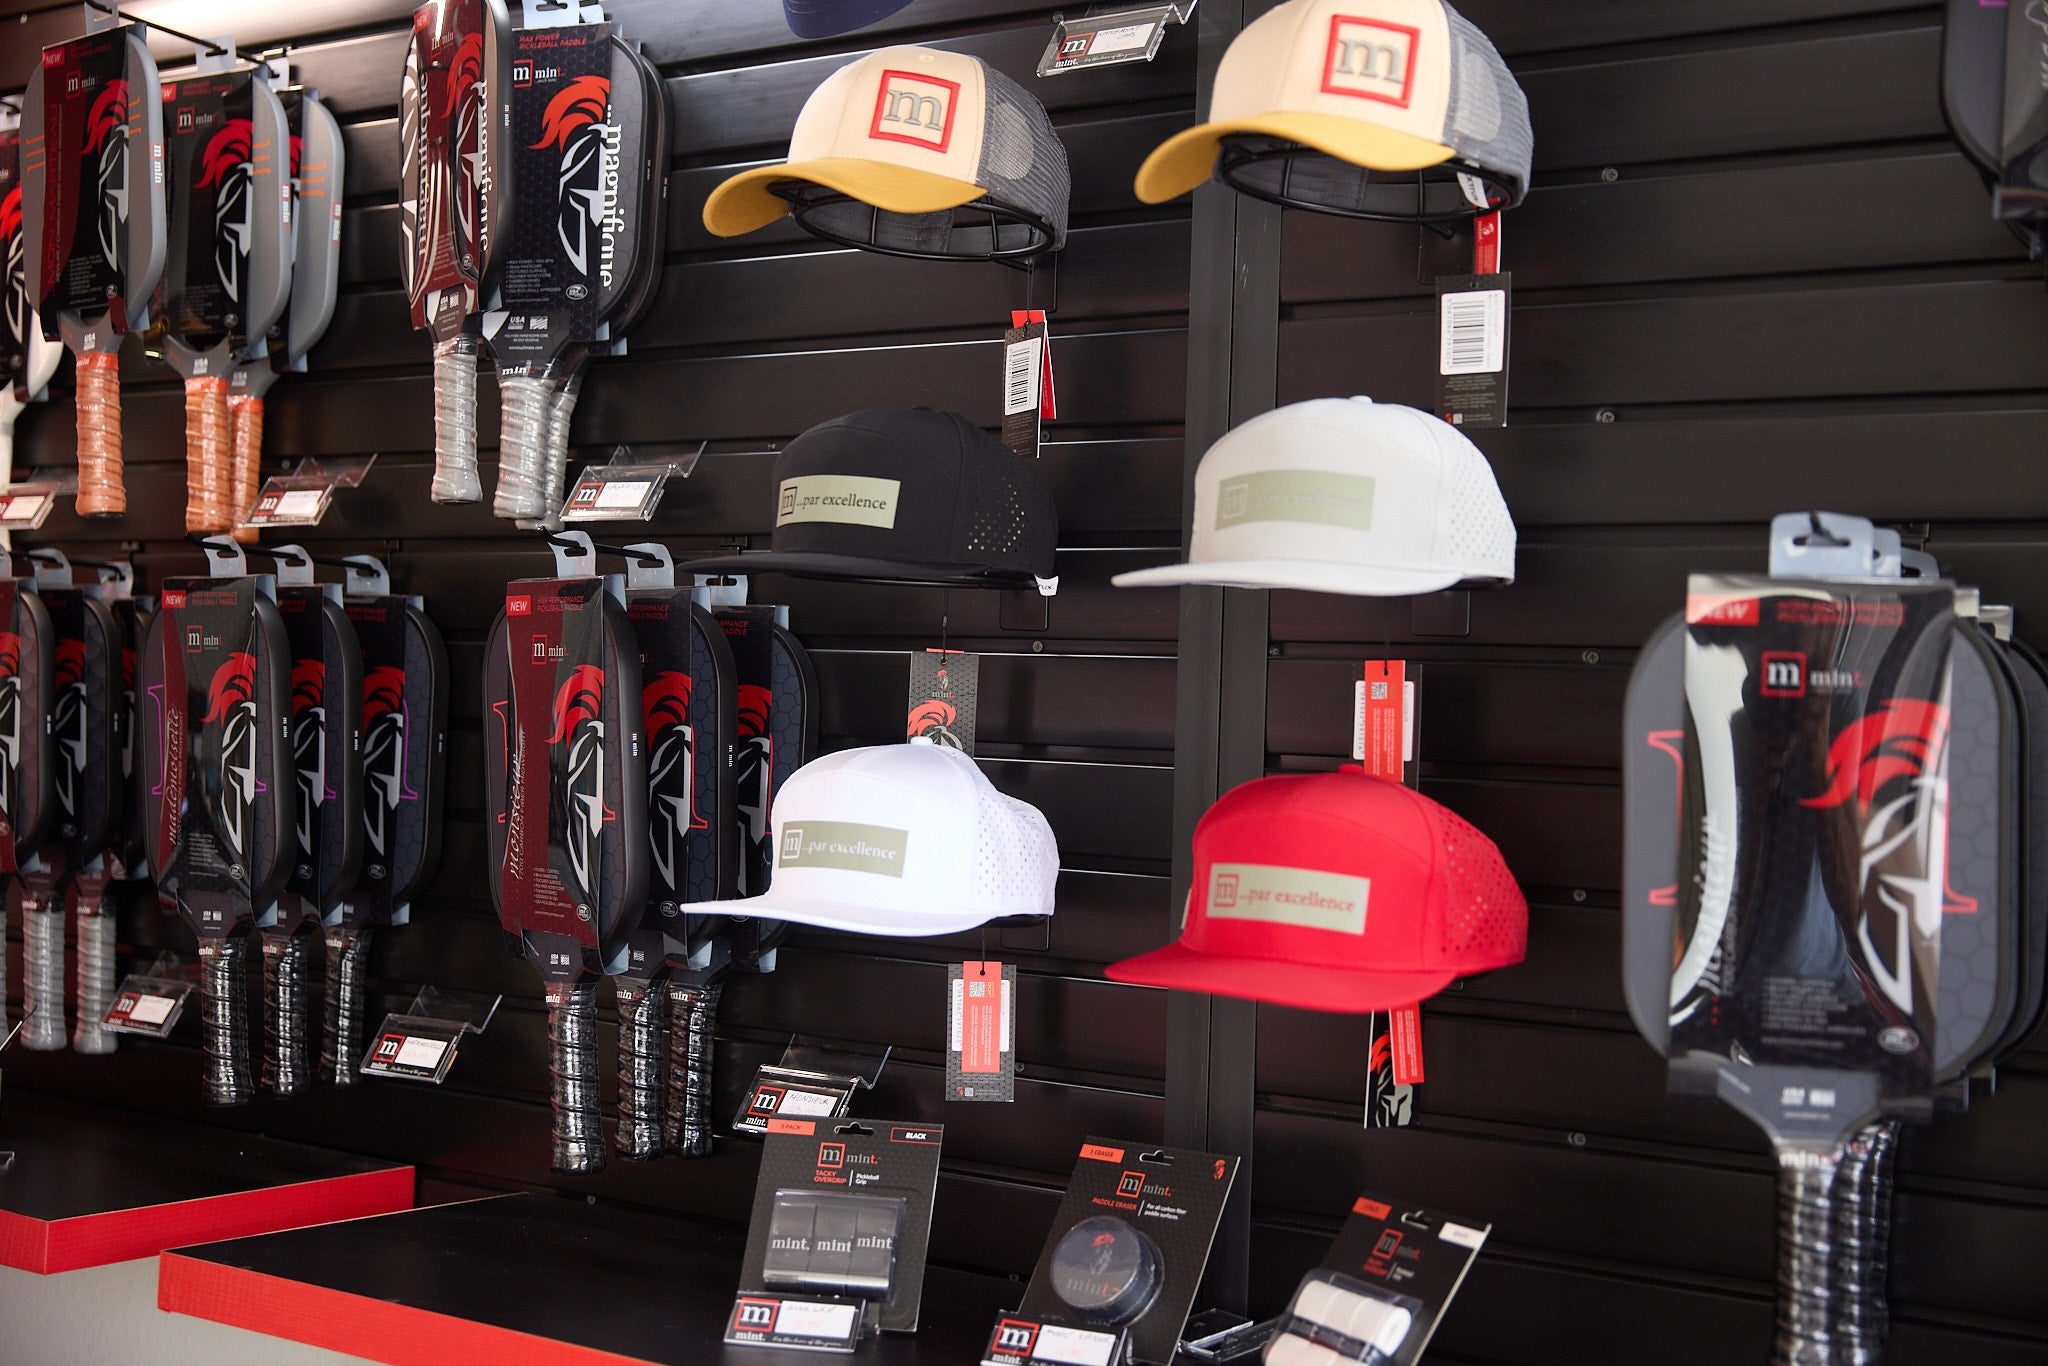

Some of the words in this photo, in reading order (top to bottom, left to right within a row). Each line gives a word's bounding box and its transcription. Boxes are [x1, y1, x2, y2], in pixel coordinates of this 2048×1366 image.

[536, 33, 560, 41] POWER
[519, 42, 559, 50] PICKLEBALL
[560, 38, 587, 46] PADDLE
[1062, 38, 1086, 53] m
[45, 52, 62, 65] NEW
[1336, 37, 1405, 85] m
[513, 66, 530, 81] m
[68, 77, 78, 92] m
[883, 88, 943, 131] m
[180, 113, 191, 127] m
[576, 488, 597, 501] m
[259, 497, 277, 510] m
[822, 493, 887, 510] excellence
[165, 595, 182, 605] NEW
[510, 601, 528, 611] NEW
[628, 604, 670, 612] ERFORMANCE
[188, 632, 200, 645] m
[533, 643, 545, 656] m
[1768, 662, 1800, 686] m
[165, 706, 179, 846] mademoiselle
[786, 837, 799, 850] m
[829, 840, 897, 859] excellence
[1217, 883, 1233, 898] m
[1274, 890, 1355, 913] excellence
[117, 998, 134, 1012] m
[378, 1040, 398, 1056] m
[753, 1093, 777, 1110] m
[745, 1116, 766, 1127] mint.
[905, 1132, 927, 1140] BLACK
[823, 1149, 840, 1161] m
[1094, 1149, 1114, 1157] ERASER
[815, 1169, 837, 1177] TACKY
[813, 1176, 847, 1184] OVERGRIP
[1122, 1177, 1139, 1191] m
[1092, 1197, 1115, 1207] PADDLE
[1115, 1200, 1137, 1210] ERASER
[1160, 1204, 1176, 1212] carbon
[1176, 1207, 1187, 1215] fiber
[1144, 1210, 1160, 1218] paddle
[771, 1237, 810, 1251] mint.
[740, 1305, 771, 1323] m
[999, 1327, 1030, 1348] m
